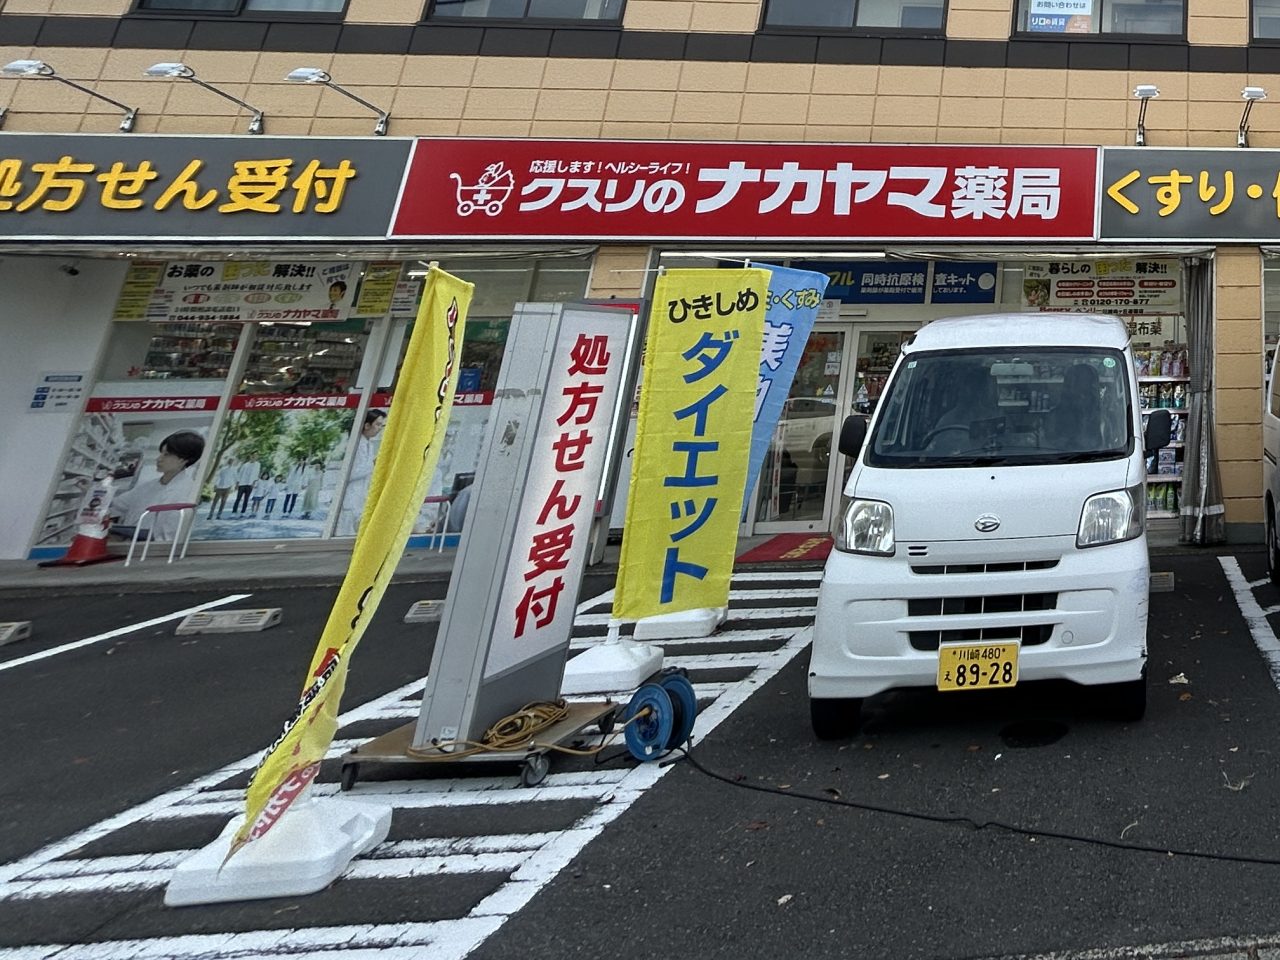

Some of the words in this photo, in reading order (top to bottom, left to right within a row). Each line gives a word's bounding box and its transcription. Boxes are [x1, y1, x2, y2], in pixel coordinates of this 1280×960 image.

[1048, 262, 1091, 275] 暮らしの
[668, 287, 759, 323] ひきしめ
[659, 329, 740, 604] ダイエット
[513, 333, 611, 640] 処方せん受付
[956, 661, 1012, 686] 89-28
